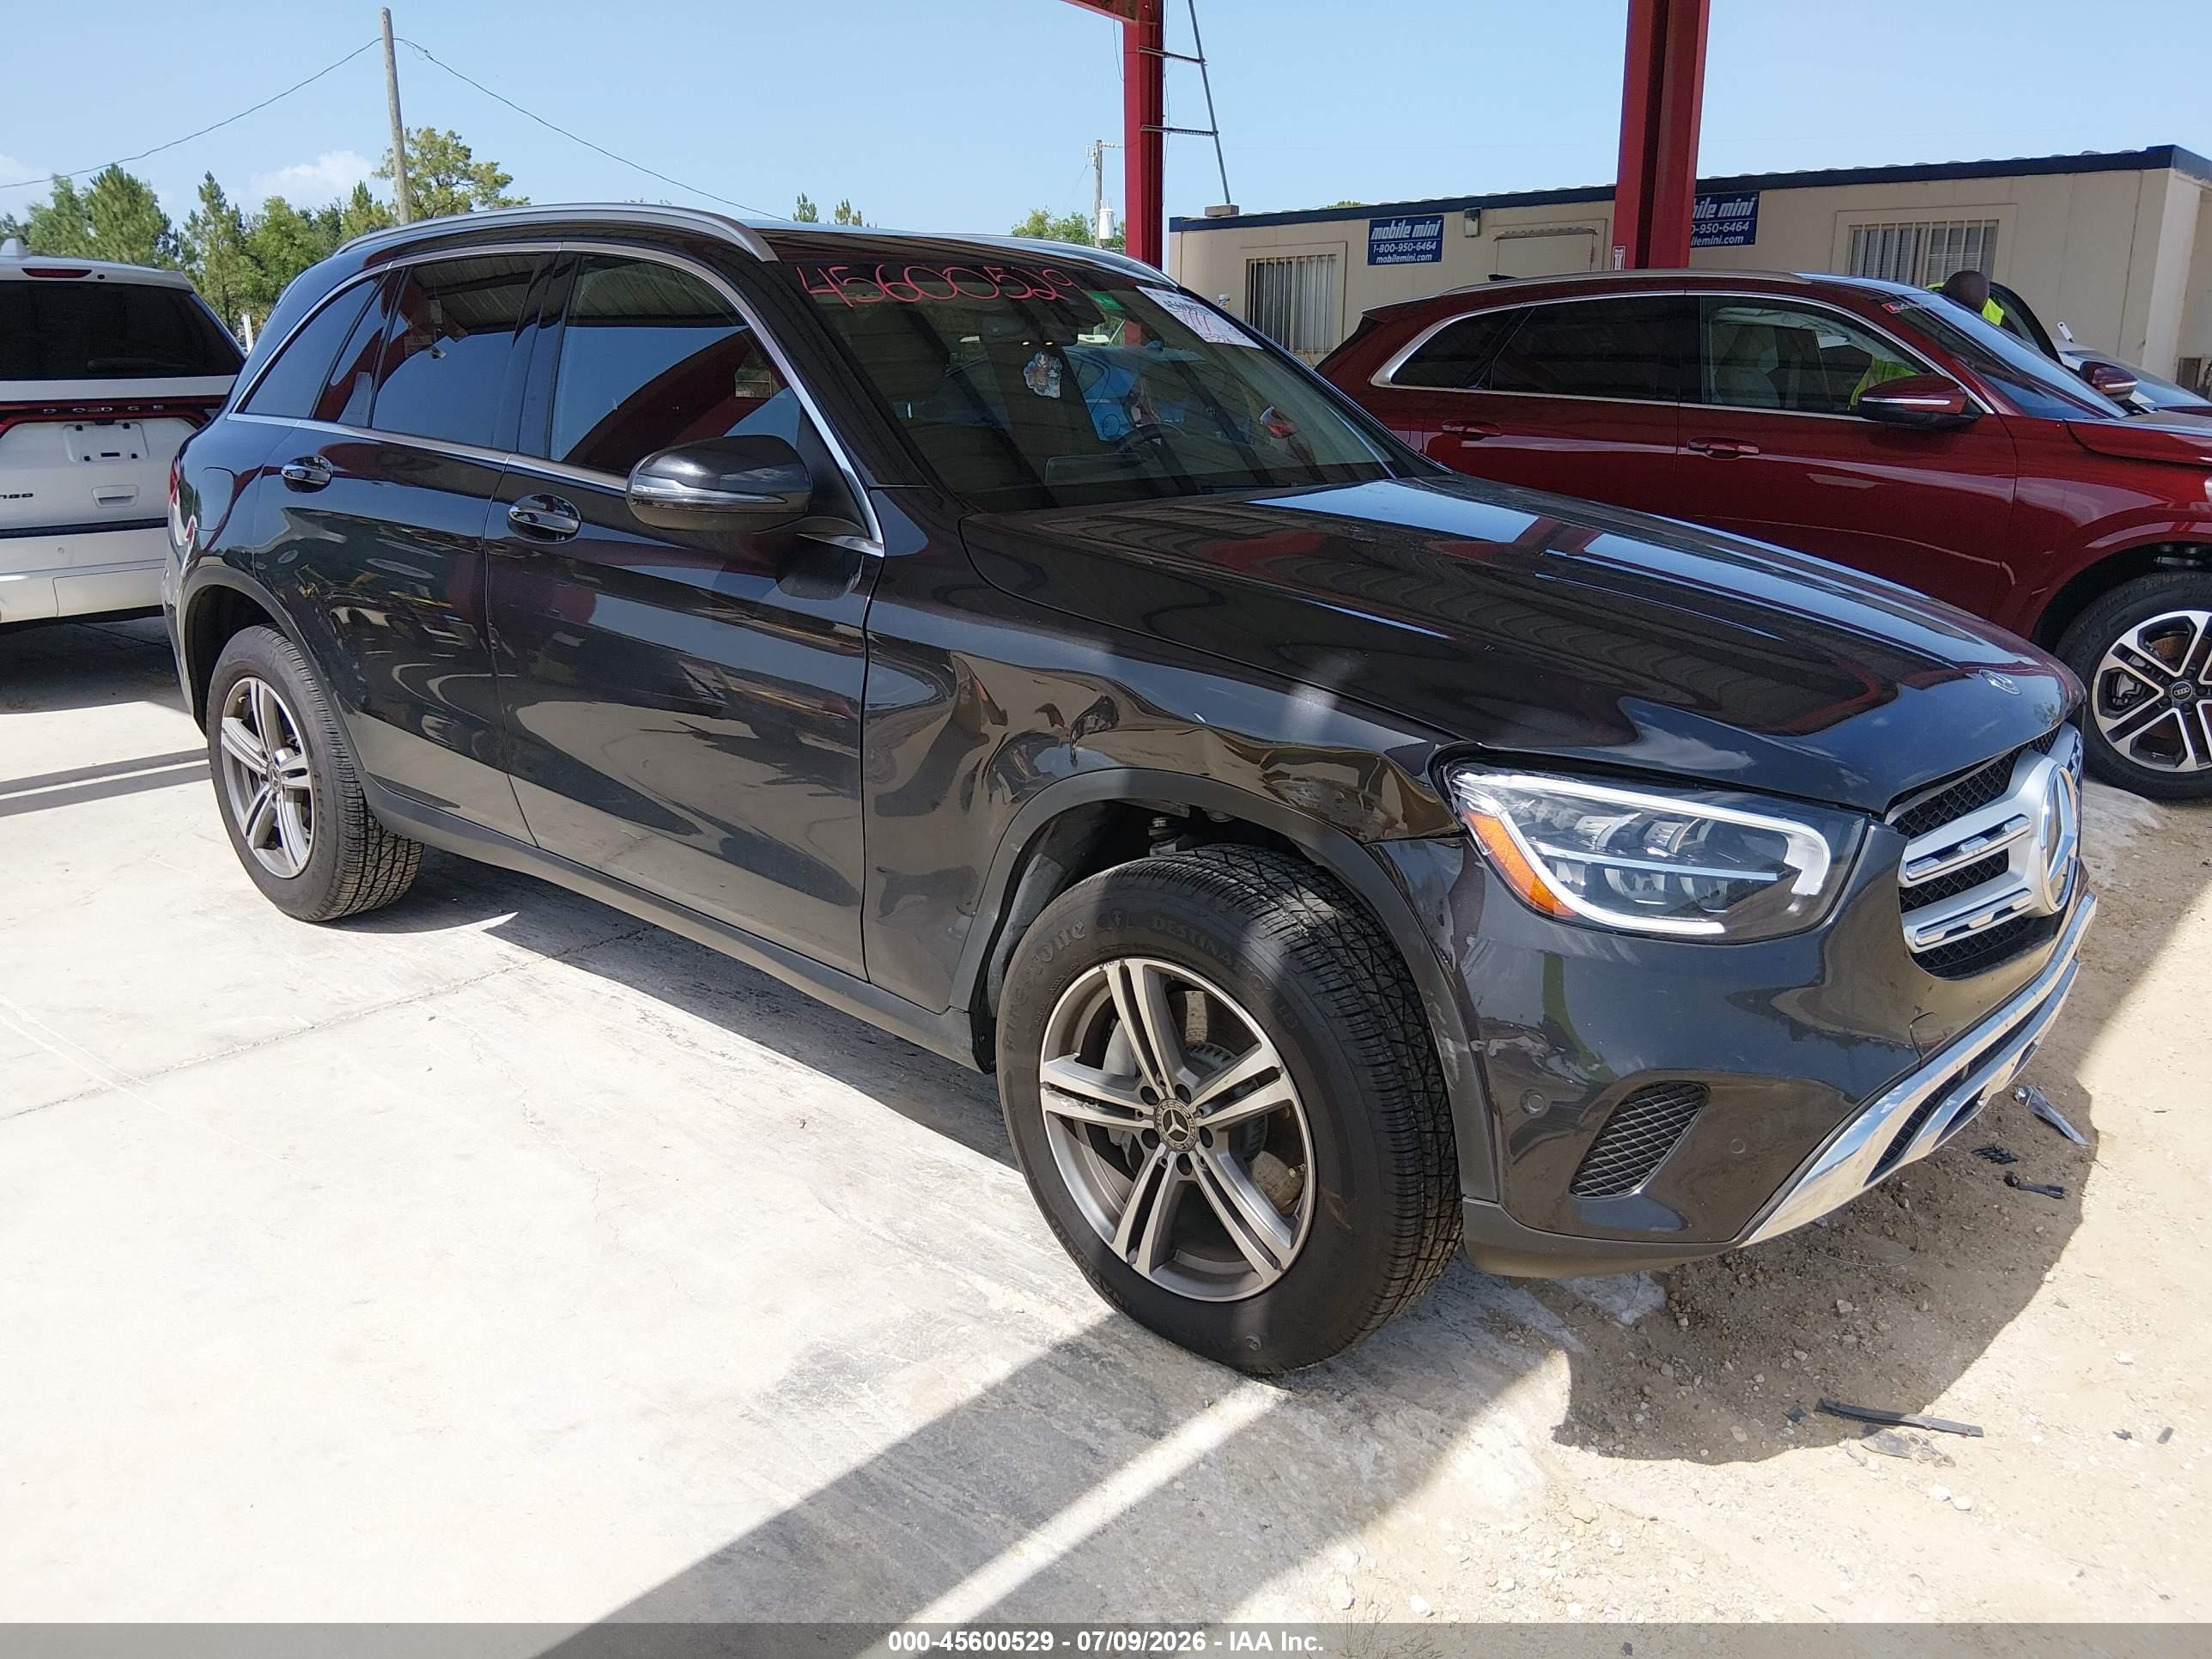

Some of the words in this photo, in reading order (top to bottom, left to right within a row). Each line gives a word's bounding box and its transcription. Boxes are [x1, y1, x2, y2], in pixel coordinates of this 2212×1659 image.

[1717, 198, 1756, 217] mini
[1370, 220, 1412, 240] mobile
[1413, 220, 1443, 238] mini
[1373, 241, 1437, 253] 1-800-950-6464
[1376, 253, 1432, 264] mobilemini.com
[796, 264, 1085, 307] 45600529
[43, 404, 164, 414] DODGE
